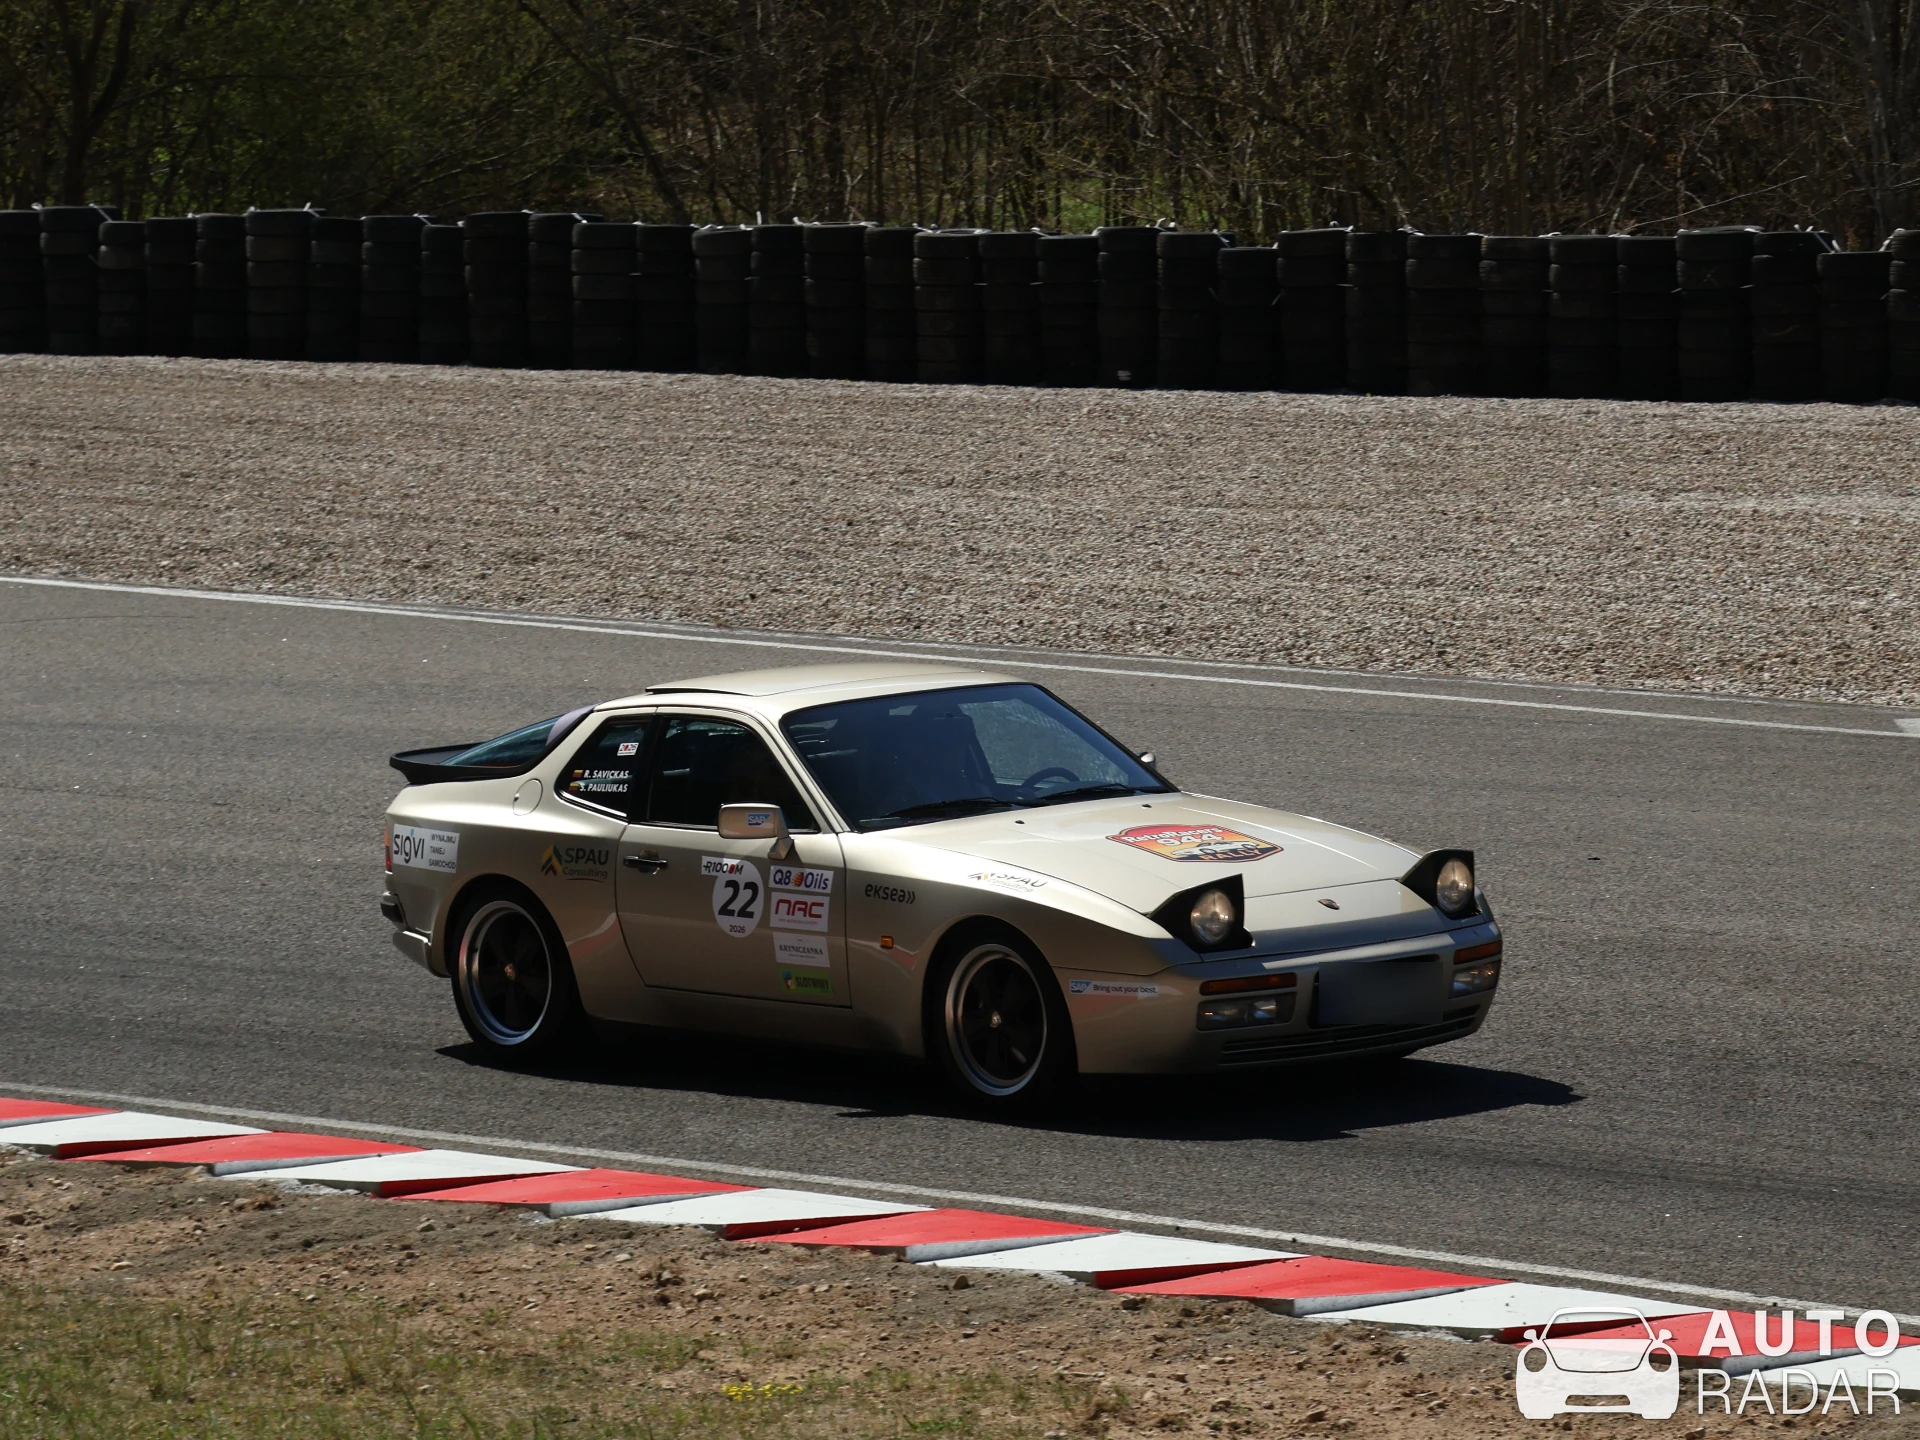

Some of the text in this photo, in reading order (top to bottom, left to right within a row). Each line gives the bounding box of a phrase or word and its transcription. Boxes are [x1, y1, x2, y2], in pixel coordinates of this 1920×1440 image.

[583, 769, 629, 779] R. SAVICKAS
[587, 783, 629, 793] PAULIUKAS
[748, 815, 766, 824] SAP
[1121, 827, 1223, 843] RetroRacers
[1156, 832, 1225, 846] 944
[430, 846, 446, 855] TANIEJ
[564, 847, 609, 865] SPAU
[1200, 849, 1263, 860] RALLY
[563, 867, 608, 879] Consulting
[773, 868, 830, 890] Q8 Oils
[718, 879, 759, 919] 22
[729, 925, 746, 934] 2026
[779, 945, 824, 956] KRYNICZANKA
[1071, 982, 1087, 991] SAP
[1093, 984, 1110, 993] Bring
[1124, 986, 1139, 994] your
[1140, 985, 1158, 994] best.
